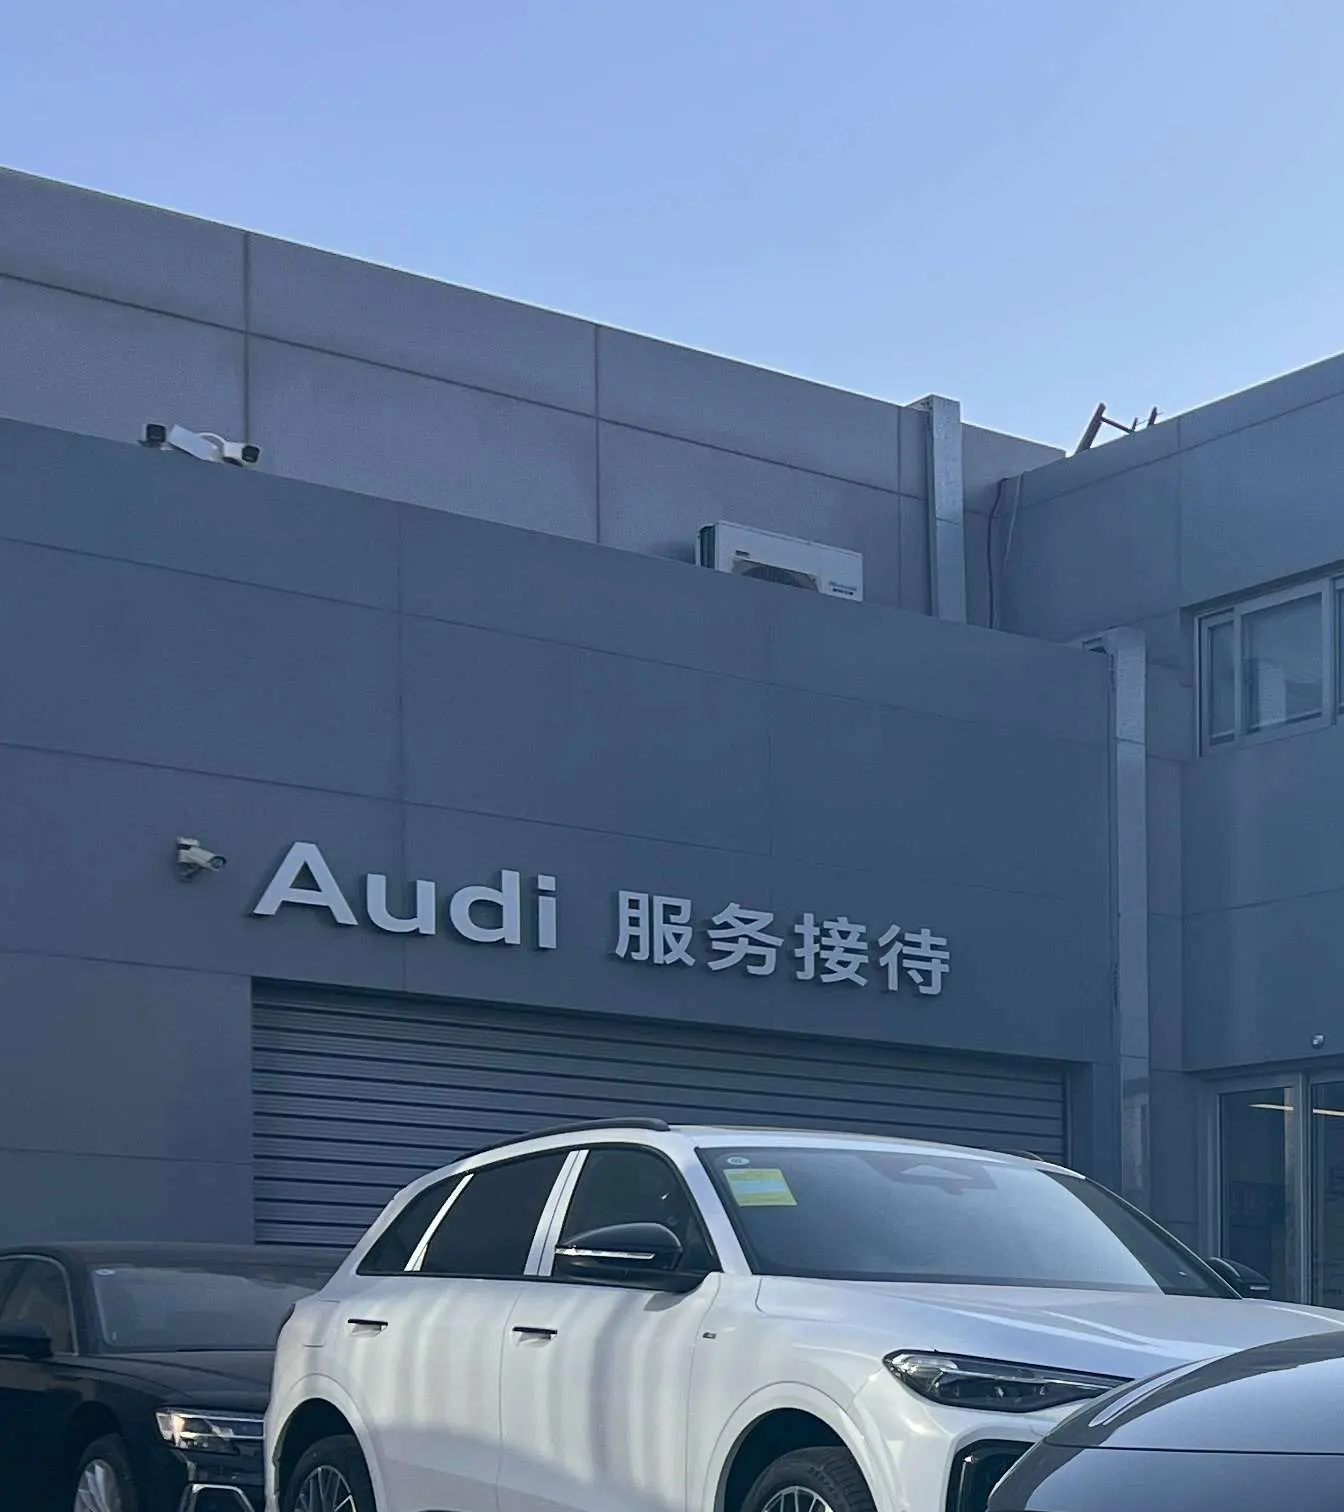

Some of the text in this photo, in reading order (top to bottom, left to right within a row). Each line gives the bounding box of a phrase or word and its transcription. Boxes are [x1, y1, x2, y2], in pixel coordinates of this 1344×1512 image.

[252, 840, 950, 996] Audi 服务接待
